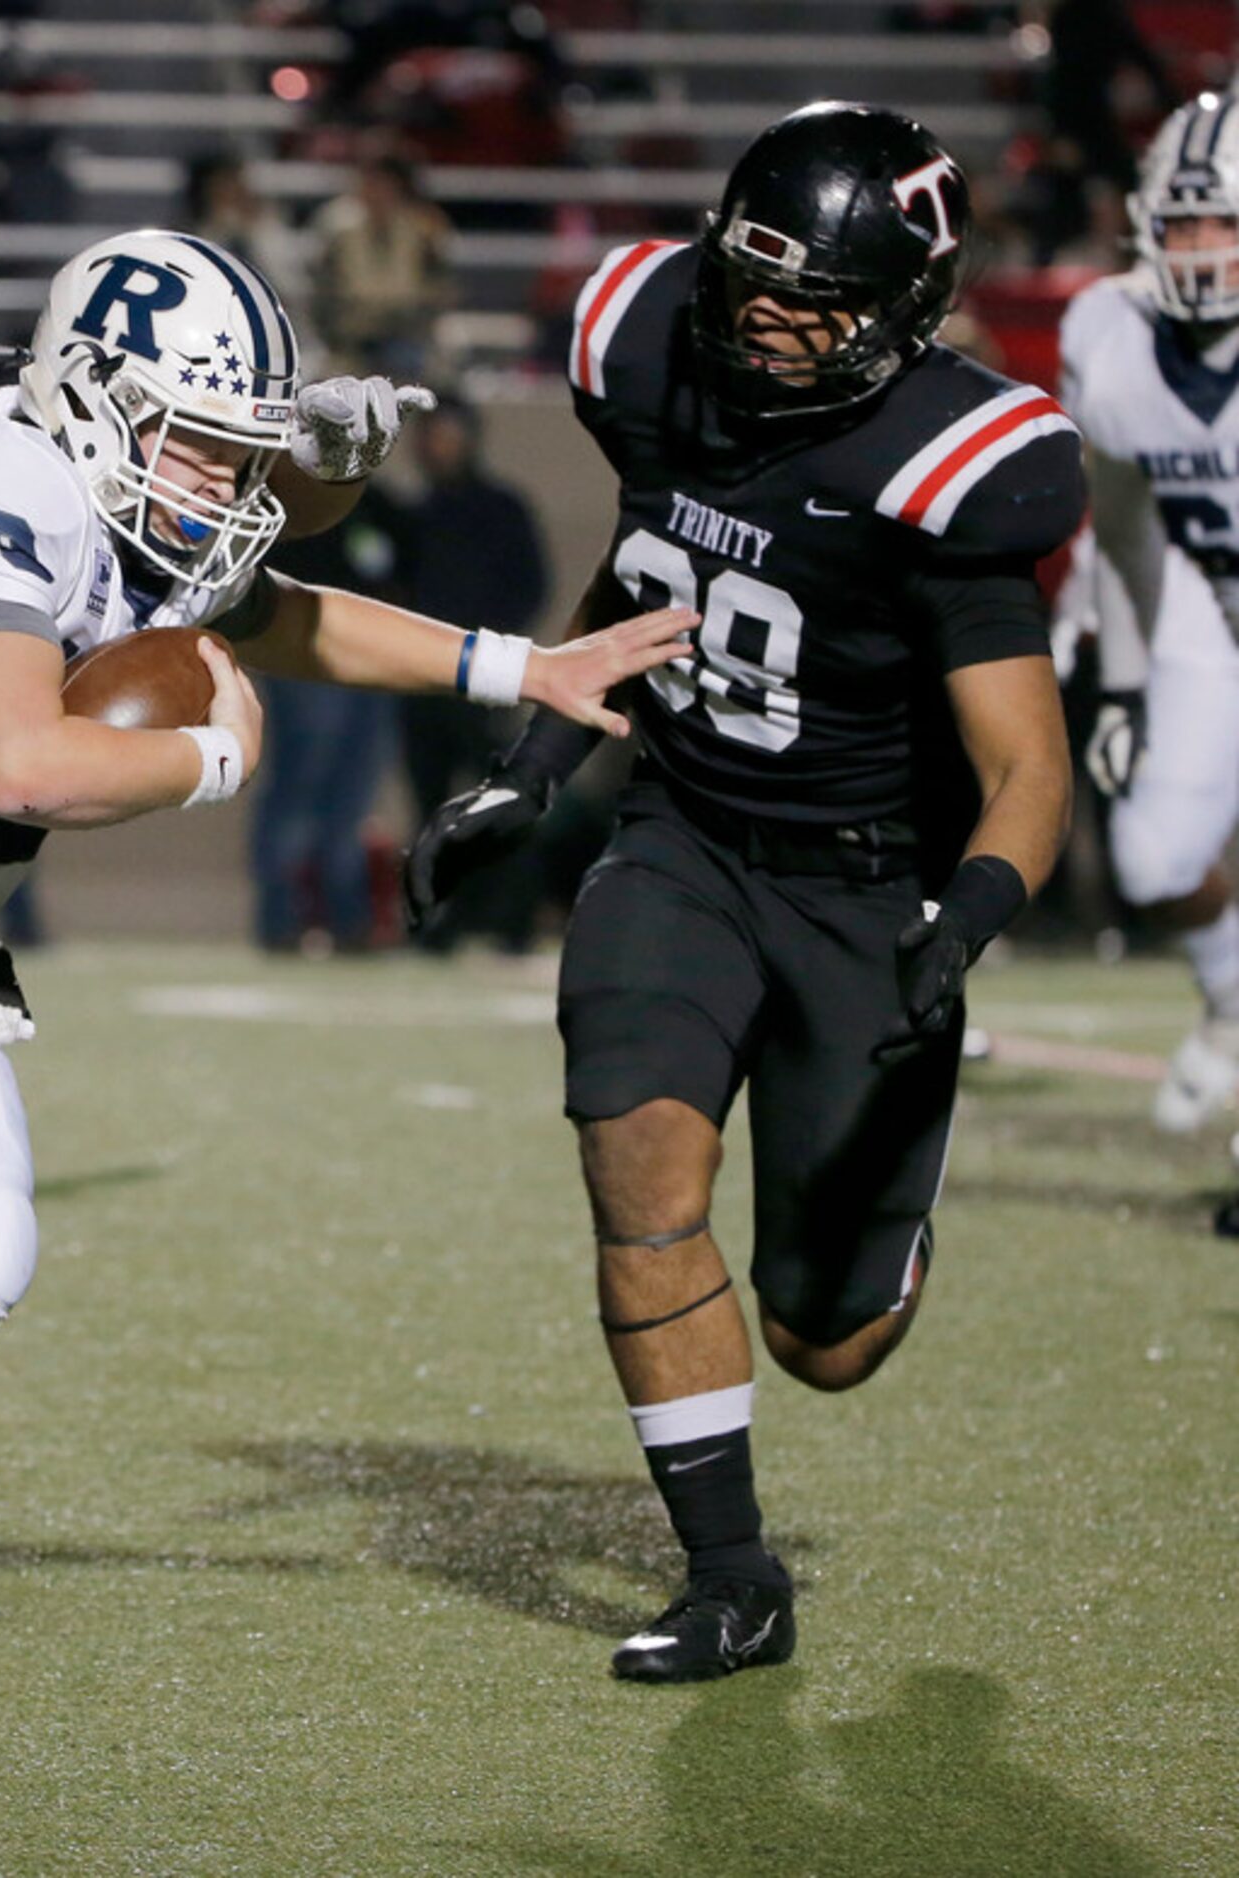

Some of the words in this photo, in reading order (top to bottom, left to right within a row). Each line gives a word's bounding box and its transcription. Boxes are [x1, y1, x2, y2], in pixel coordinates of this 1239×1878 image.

[892, 157, 959, 259] T
[71, 254, 187, 364] R
[667, 491, 774, 568] TRINITY
